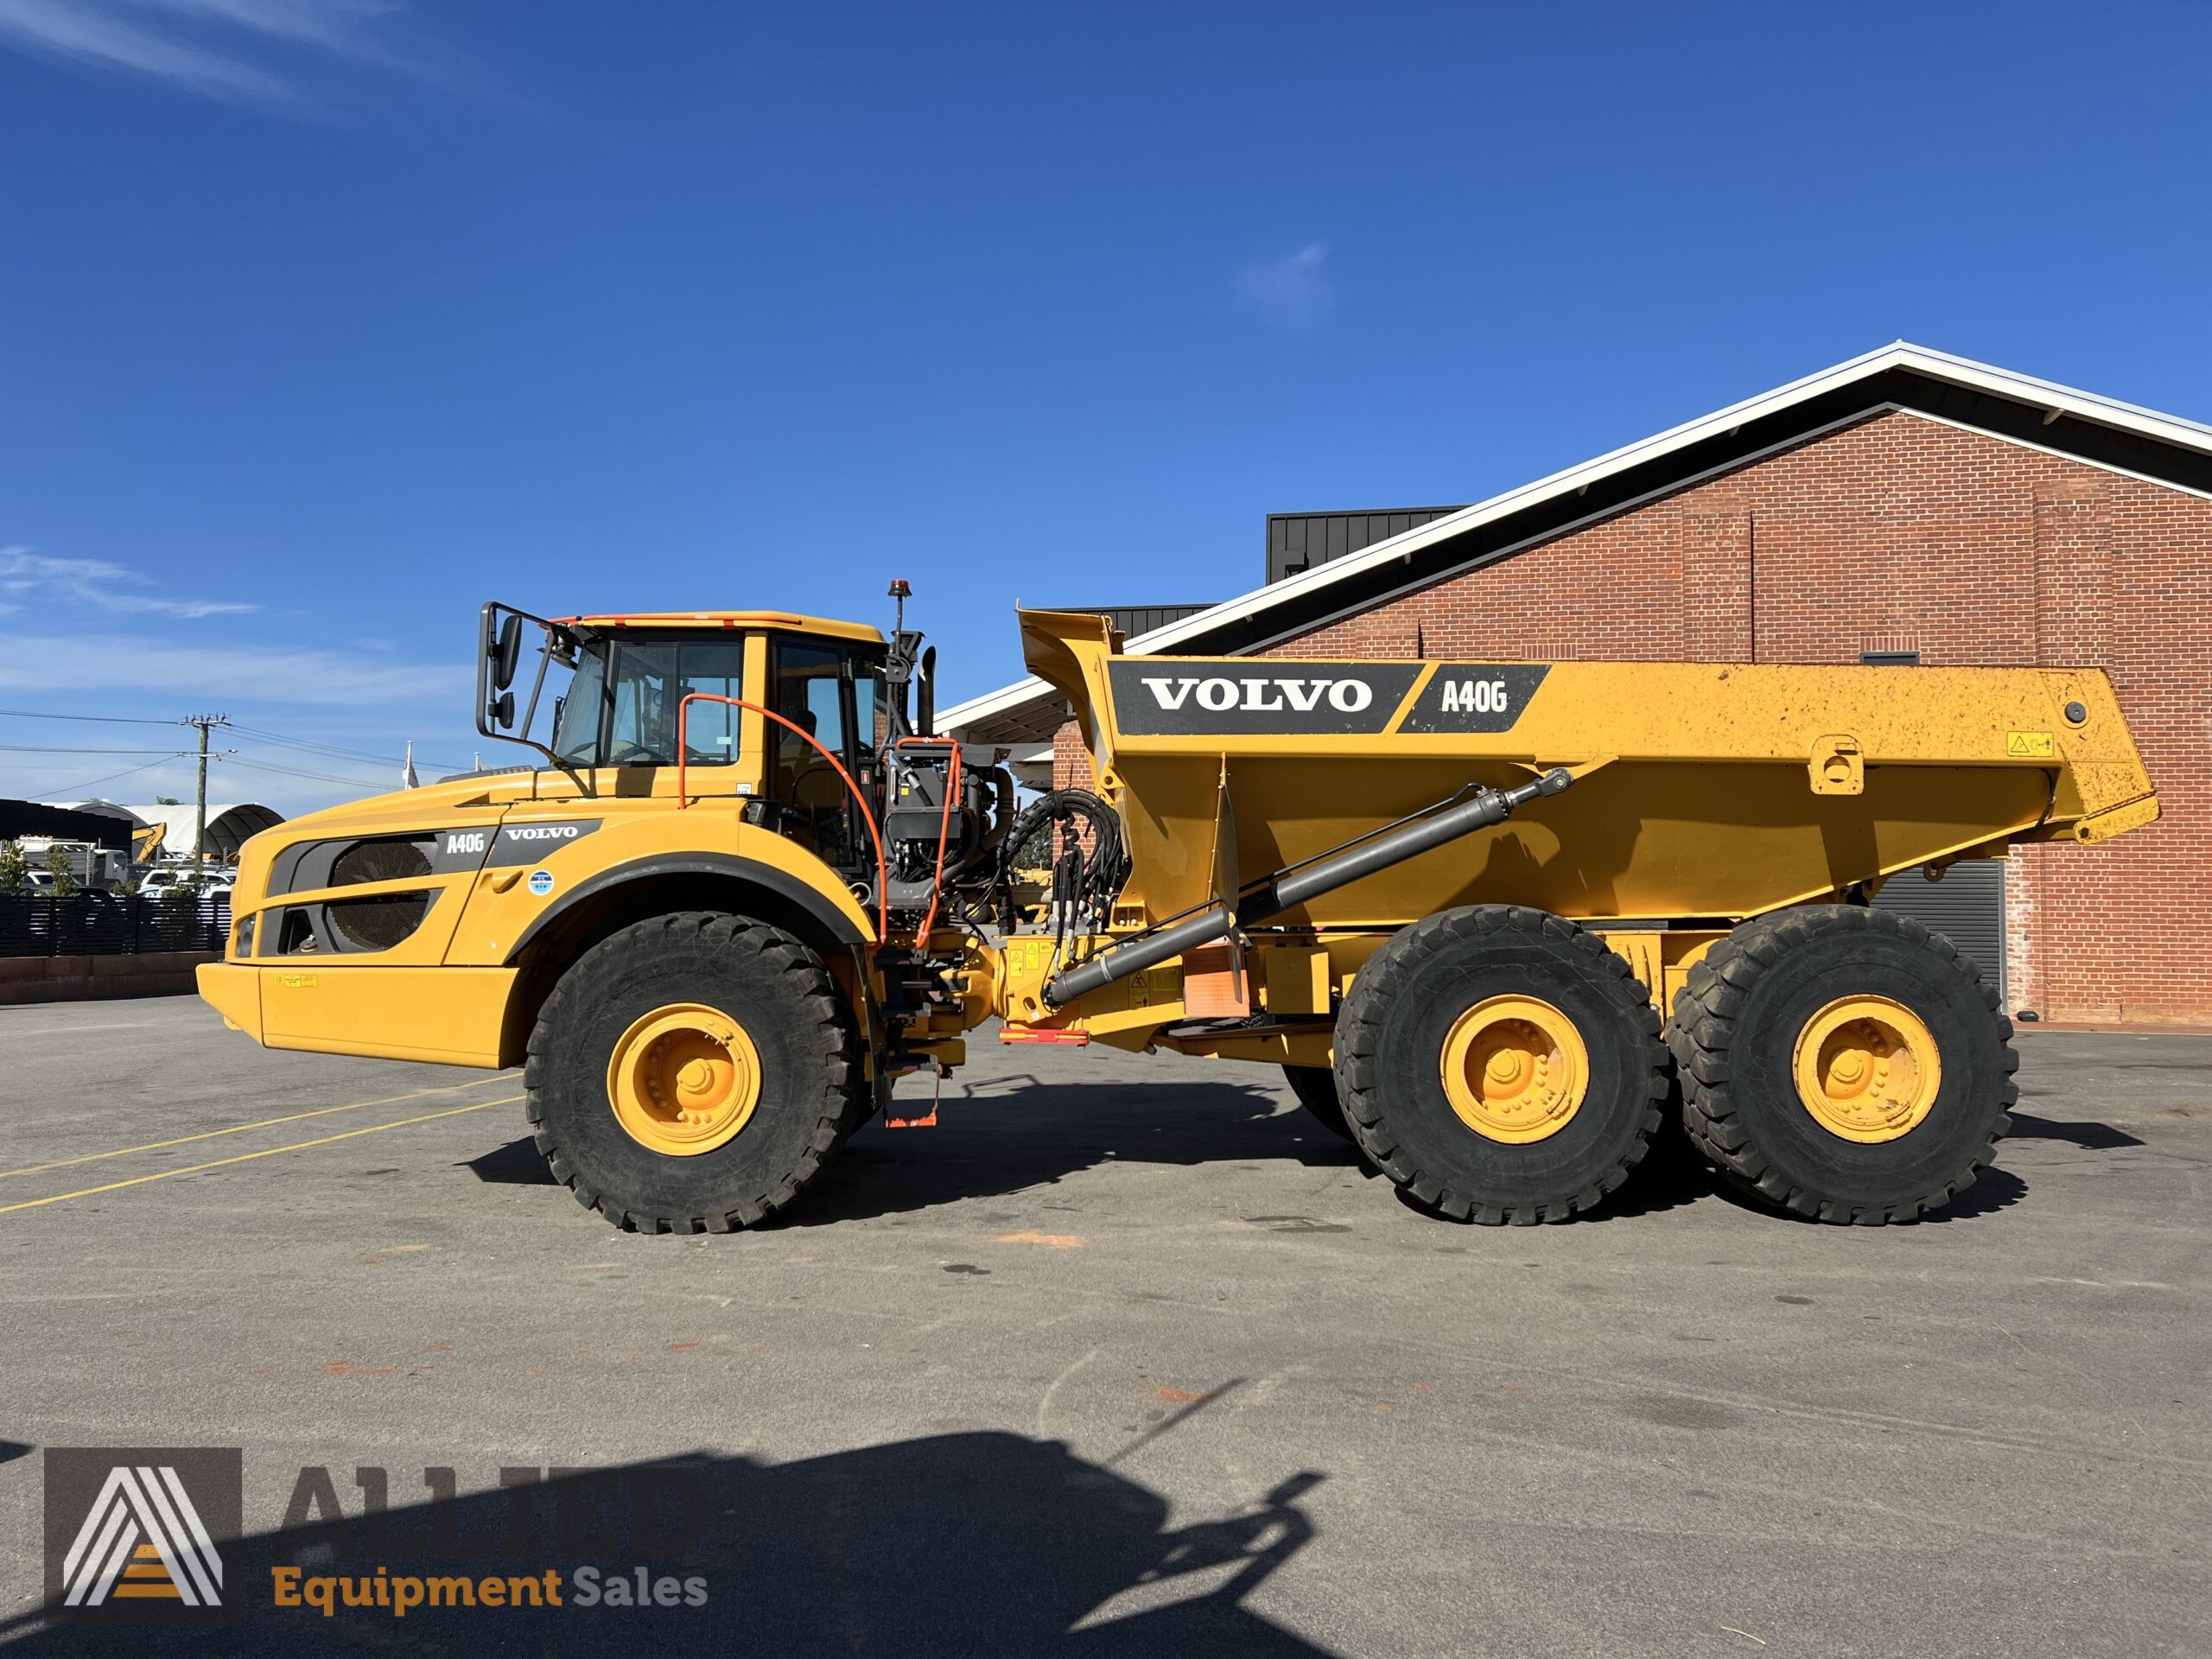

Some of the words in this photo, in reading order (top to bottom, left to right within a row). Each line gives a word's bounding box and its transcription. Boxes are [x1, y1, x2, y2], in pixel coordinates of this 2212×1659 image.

[1141, 677, 1372, 712] VOLVO
[1441, 680, 1507, 712] A40G
[447, 833, 484, 854] A40G
[505, 826, 578, 841] VOLVO
